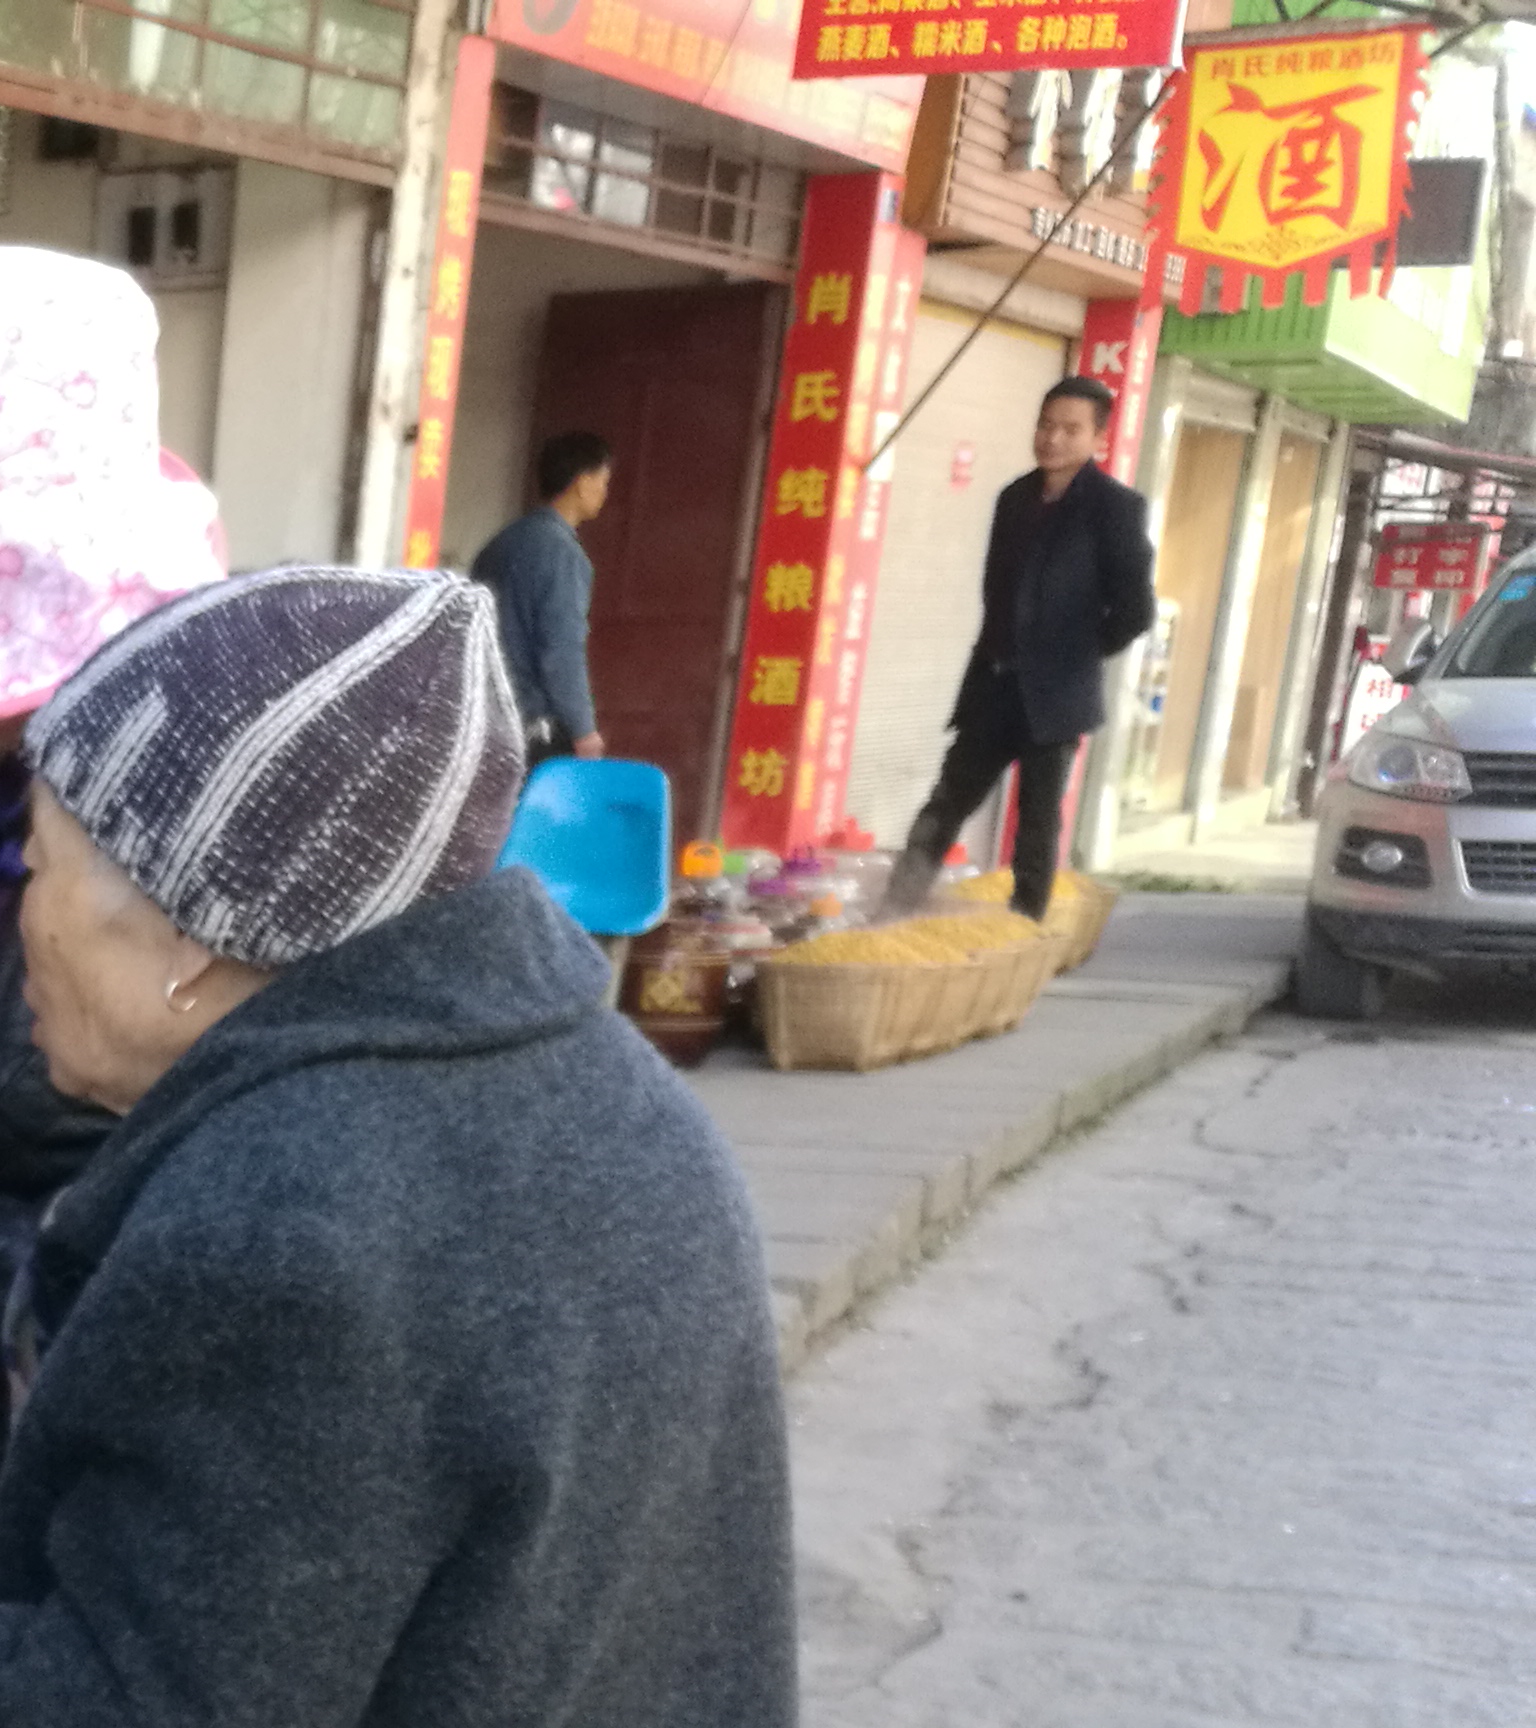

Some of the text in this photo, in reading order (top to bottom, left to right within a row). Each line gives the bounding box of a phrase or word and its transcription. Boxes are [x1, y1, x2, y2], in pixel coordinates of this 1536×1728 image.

[1198, 81, 1383, 235] 酒
[738, 272, 852, 800] 肖氏纯粮酒坊
